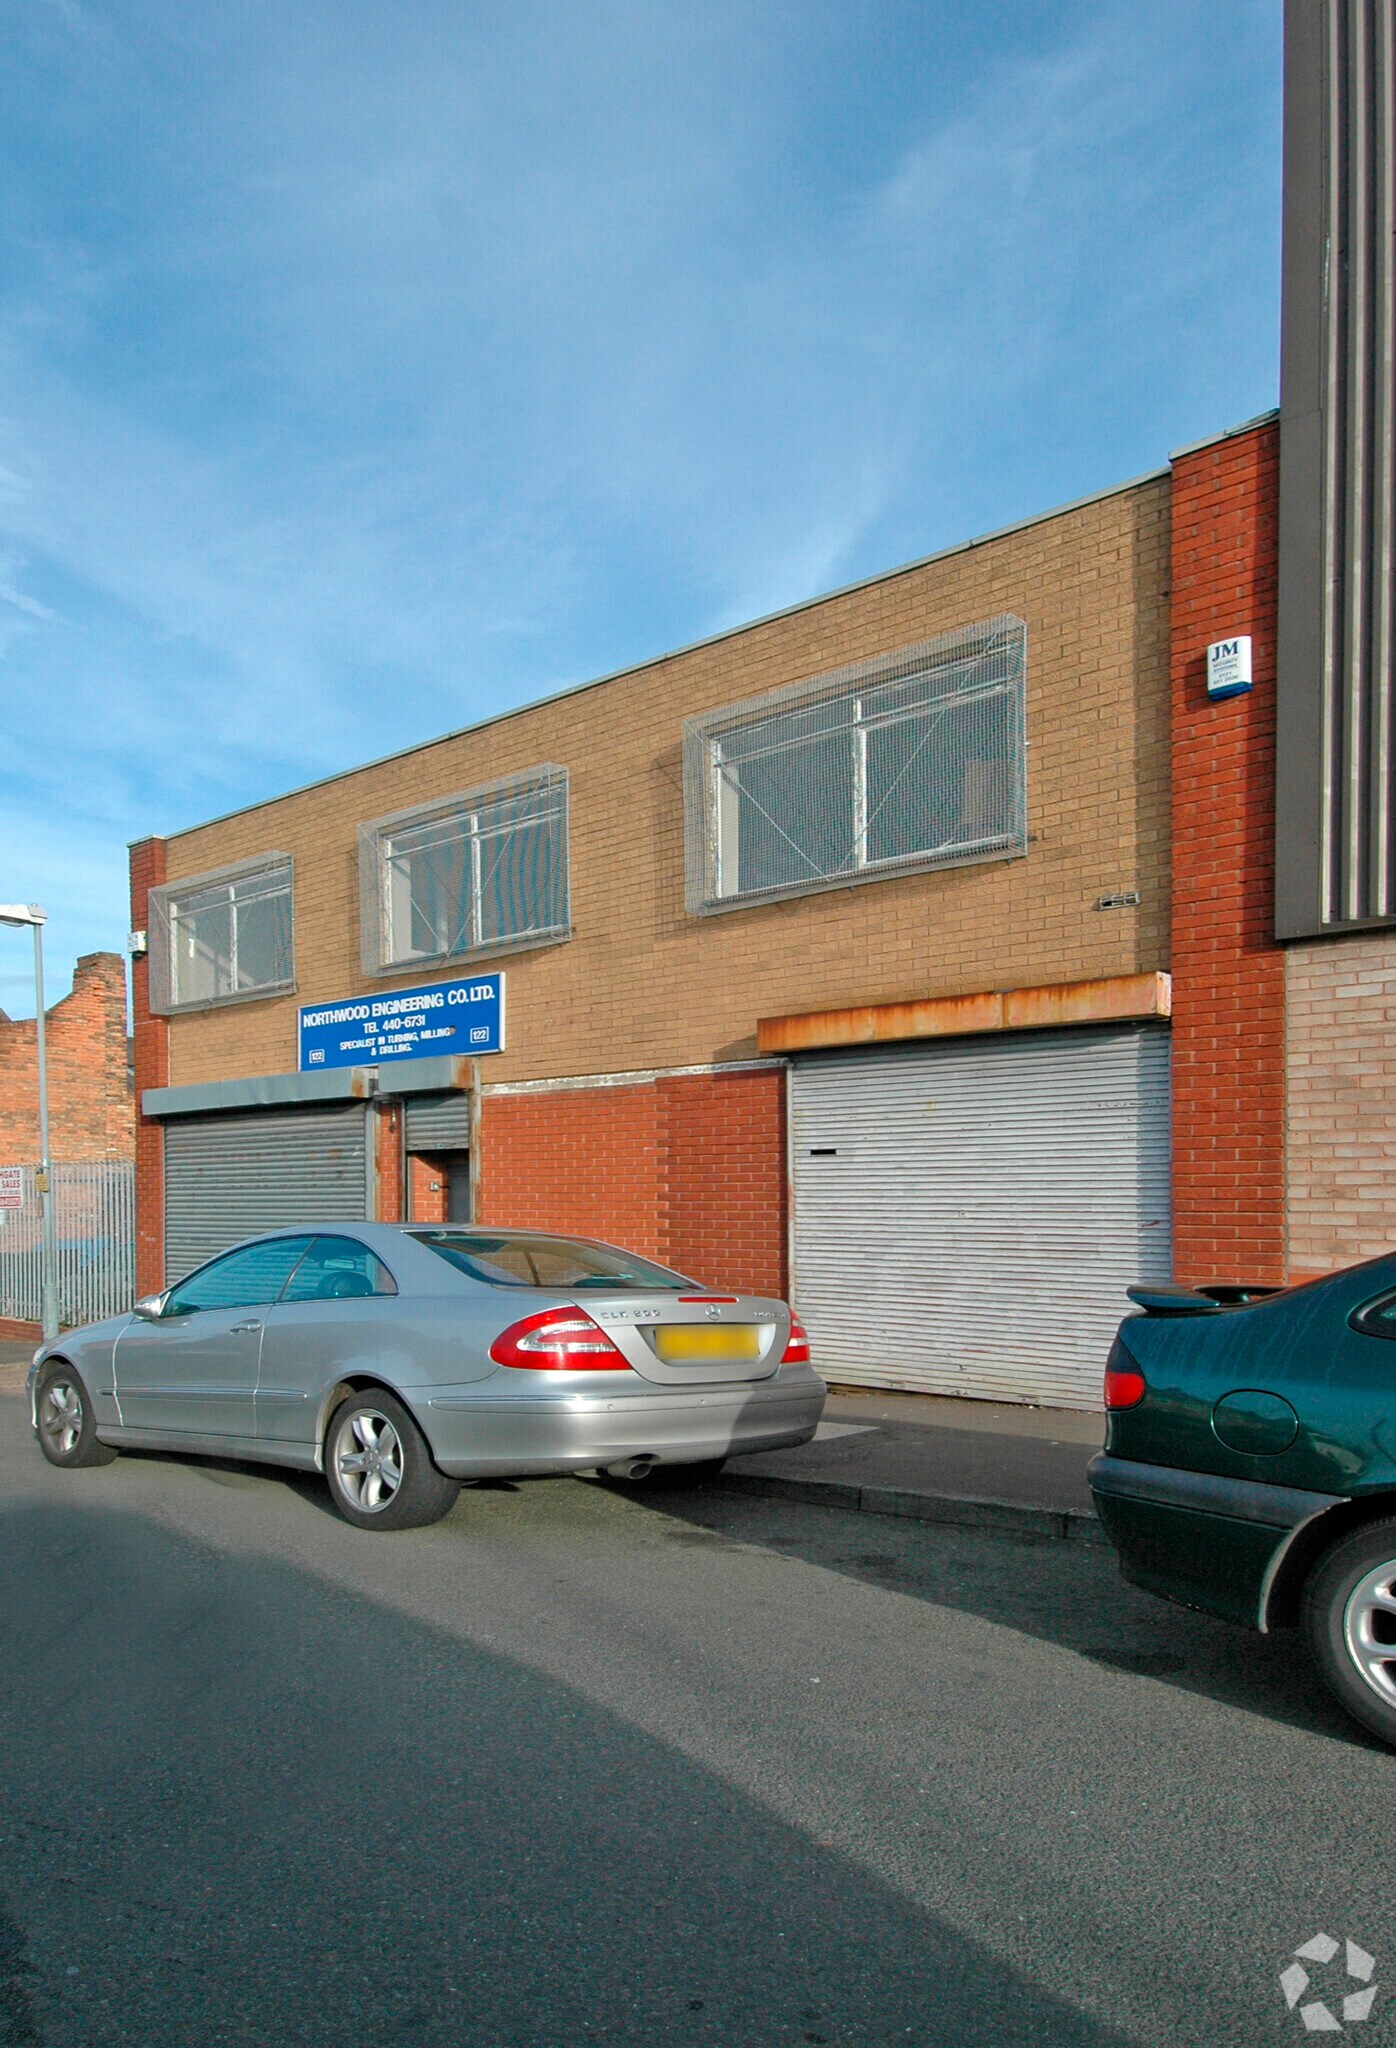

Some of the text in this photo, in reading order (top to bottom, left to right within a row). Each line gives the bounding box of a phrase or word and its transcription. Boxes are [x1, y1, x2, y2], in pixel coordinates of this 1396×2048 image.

[1212, 641, 1238, 662] JM
[303, 1006, 370, 1027] NORTHWOOD
[372, 993, 444, 1016] ENGINEERING
[382, 1014, 426, 1031] 440-6731
[339, 1037, 376, 1050] SPECIALIST
[420, 1027, 451, 1040] MILLING
[473, 1030, 487, 1041] 122
[370, 1047, 377, 1056] &
[2, 1180, 20, 1188] SALES
[601, 1310, 661, 1319] CLK 200
